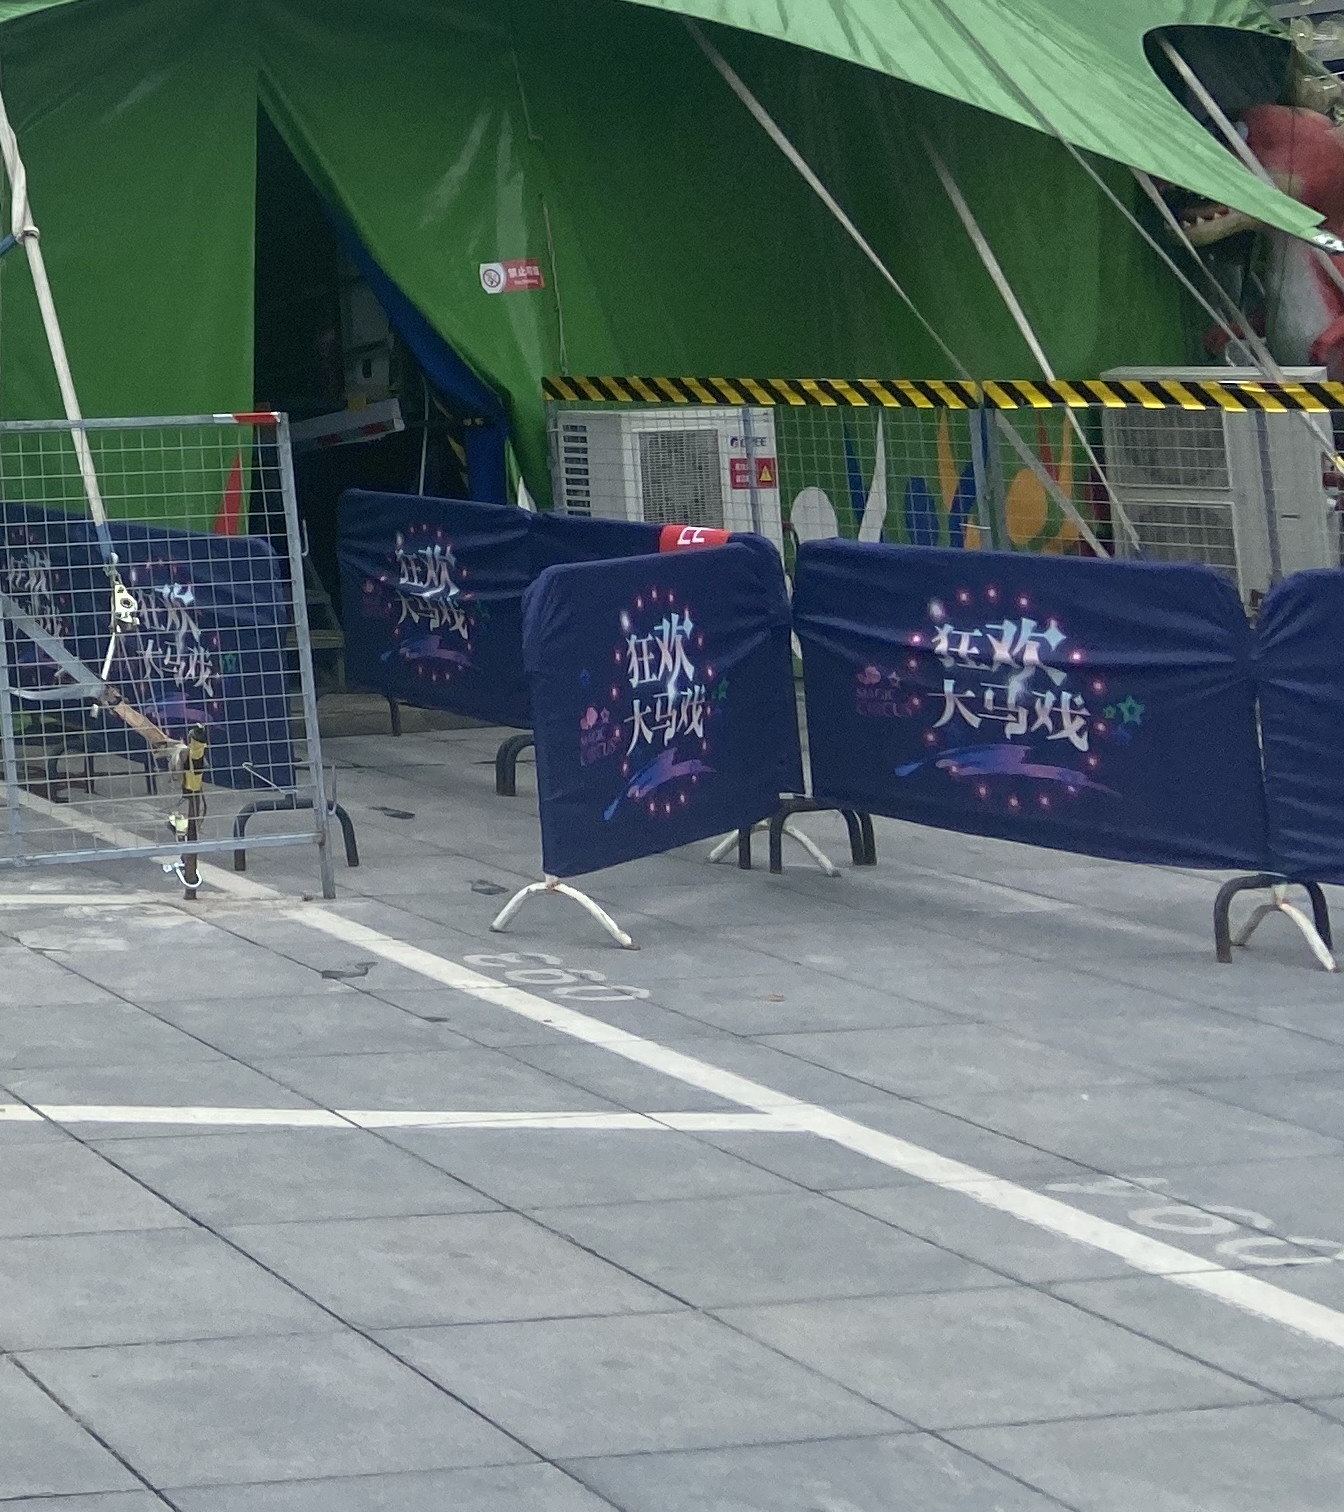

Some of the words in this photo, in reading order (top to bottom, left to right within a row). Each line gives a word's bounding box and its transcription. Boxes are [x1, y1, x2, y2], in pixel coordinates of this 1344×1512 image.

[625, 613, 695, 688] 狂欢
[931, 617, 1068, 686] 狂欢
[624, 684, 706, 756] 大马戏
[927, 678, 1091, 752] 大马戏
